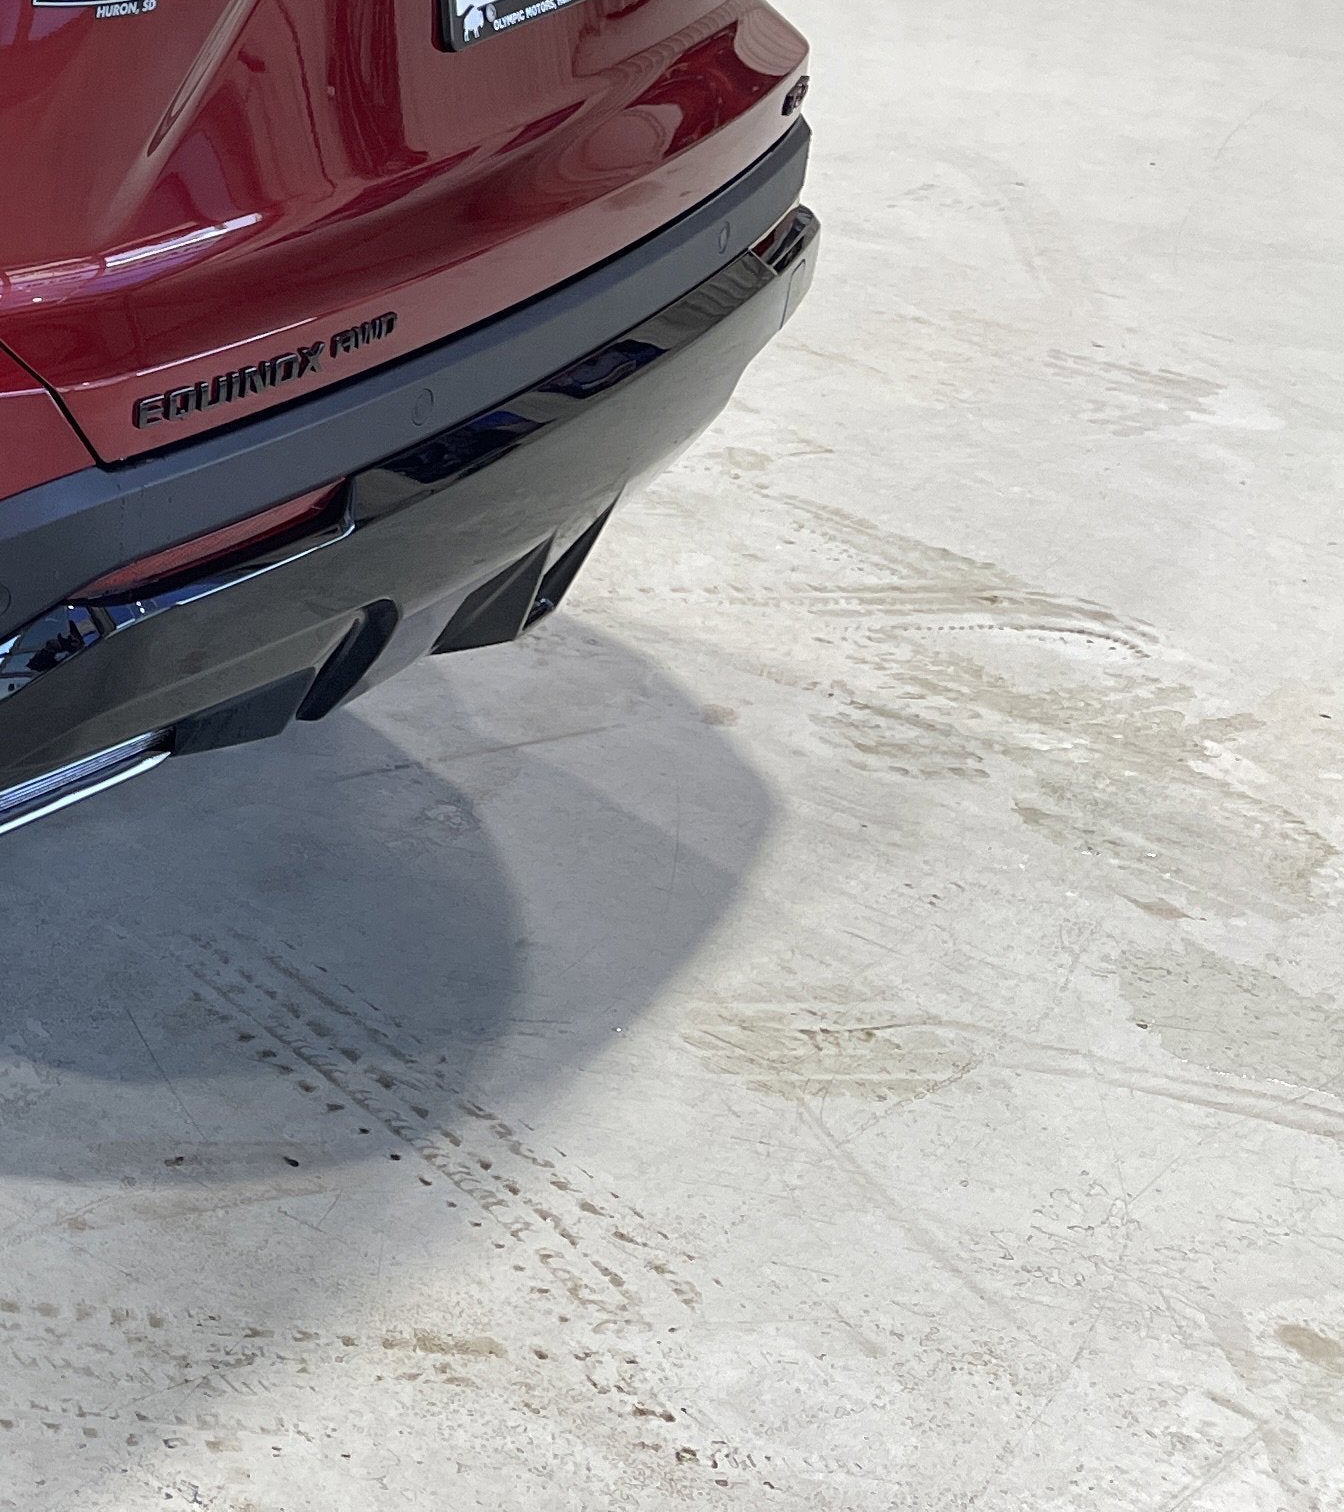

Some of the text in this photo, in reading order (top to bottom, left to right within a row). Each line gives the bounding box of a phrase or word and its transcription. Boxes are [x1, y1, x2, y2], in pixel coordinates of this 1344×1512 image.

[95, 1, 140, 19] HURON,
[493, 10, 525, 31] OLYMPIC
[131, 310, 399, 430] EQUINOX AWD
